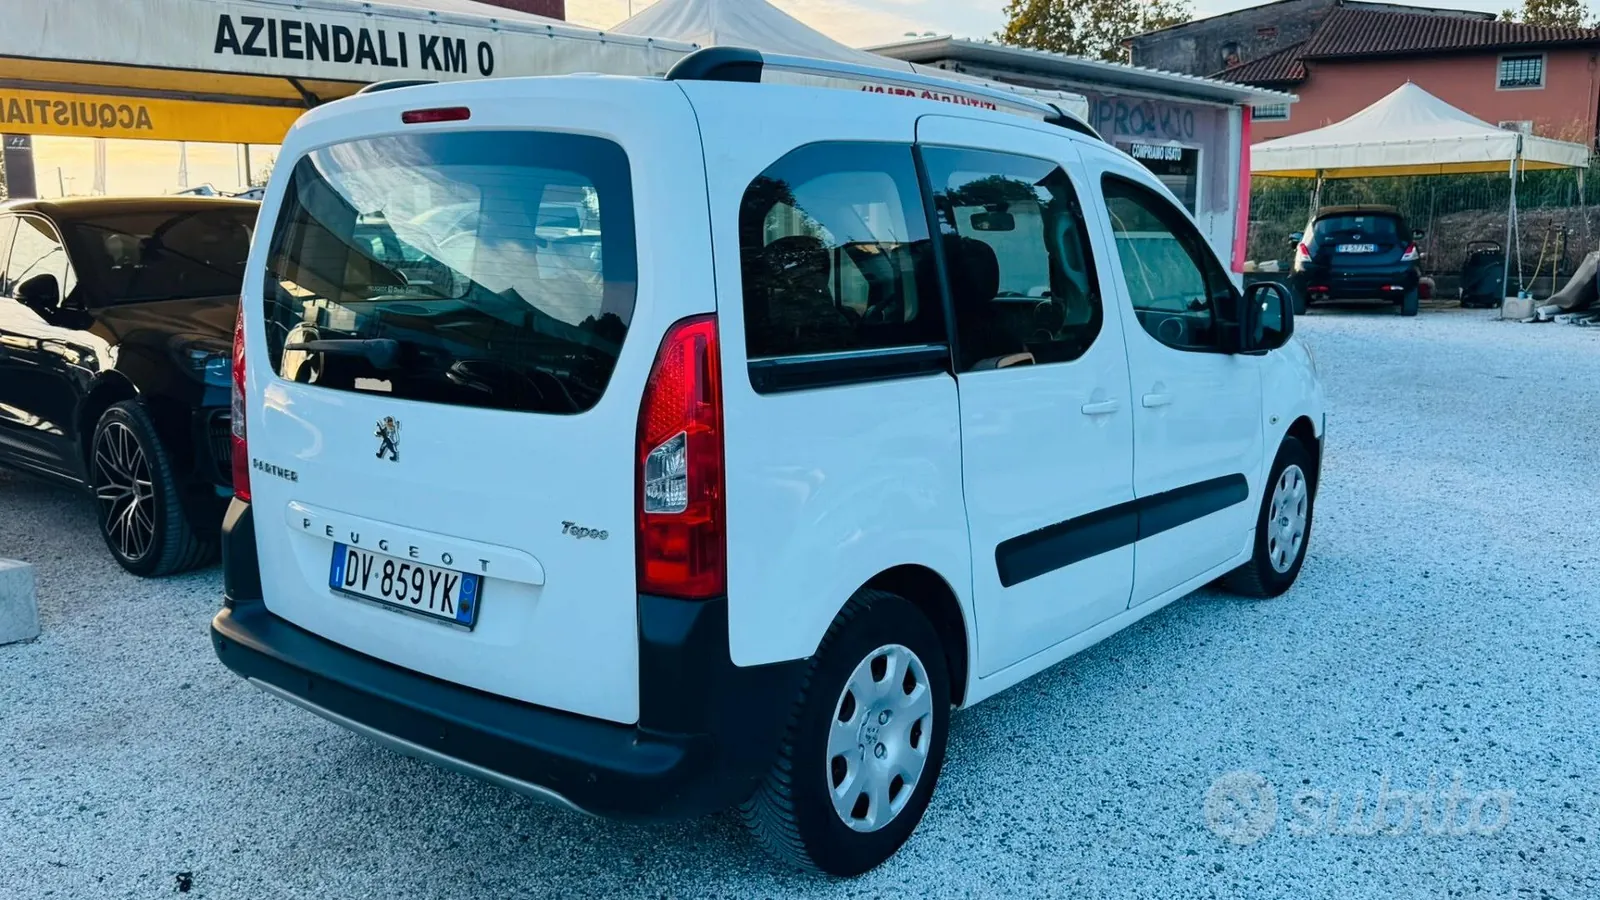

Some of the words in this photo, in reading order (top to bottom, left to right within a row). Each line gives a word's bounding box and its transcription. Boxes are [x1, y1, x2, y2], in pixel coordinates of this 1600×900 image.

[214, 13, 408, 68] AZIENDALI
[419, 34, 467, 74] KM
[252, 458, 298, 482] PARTNER
[303, 518, 491, 572] PEUGEOT
